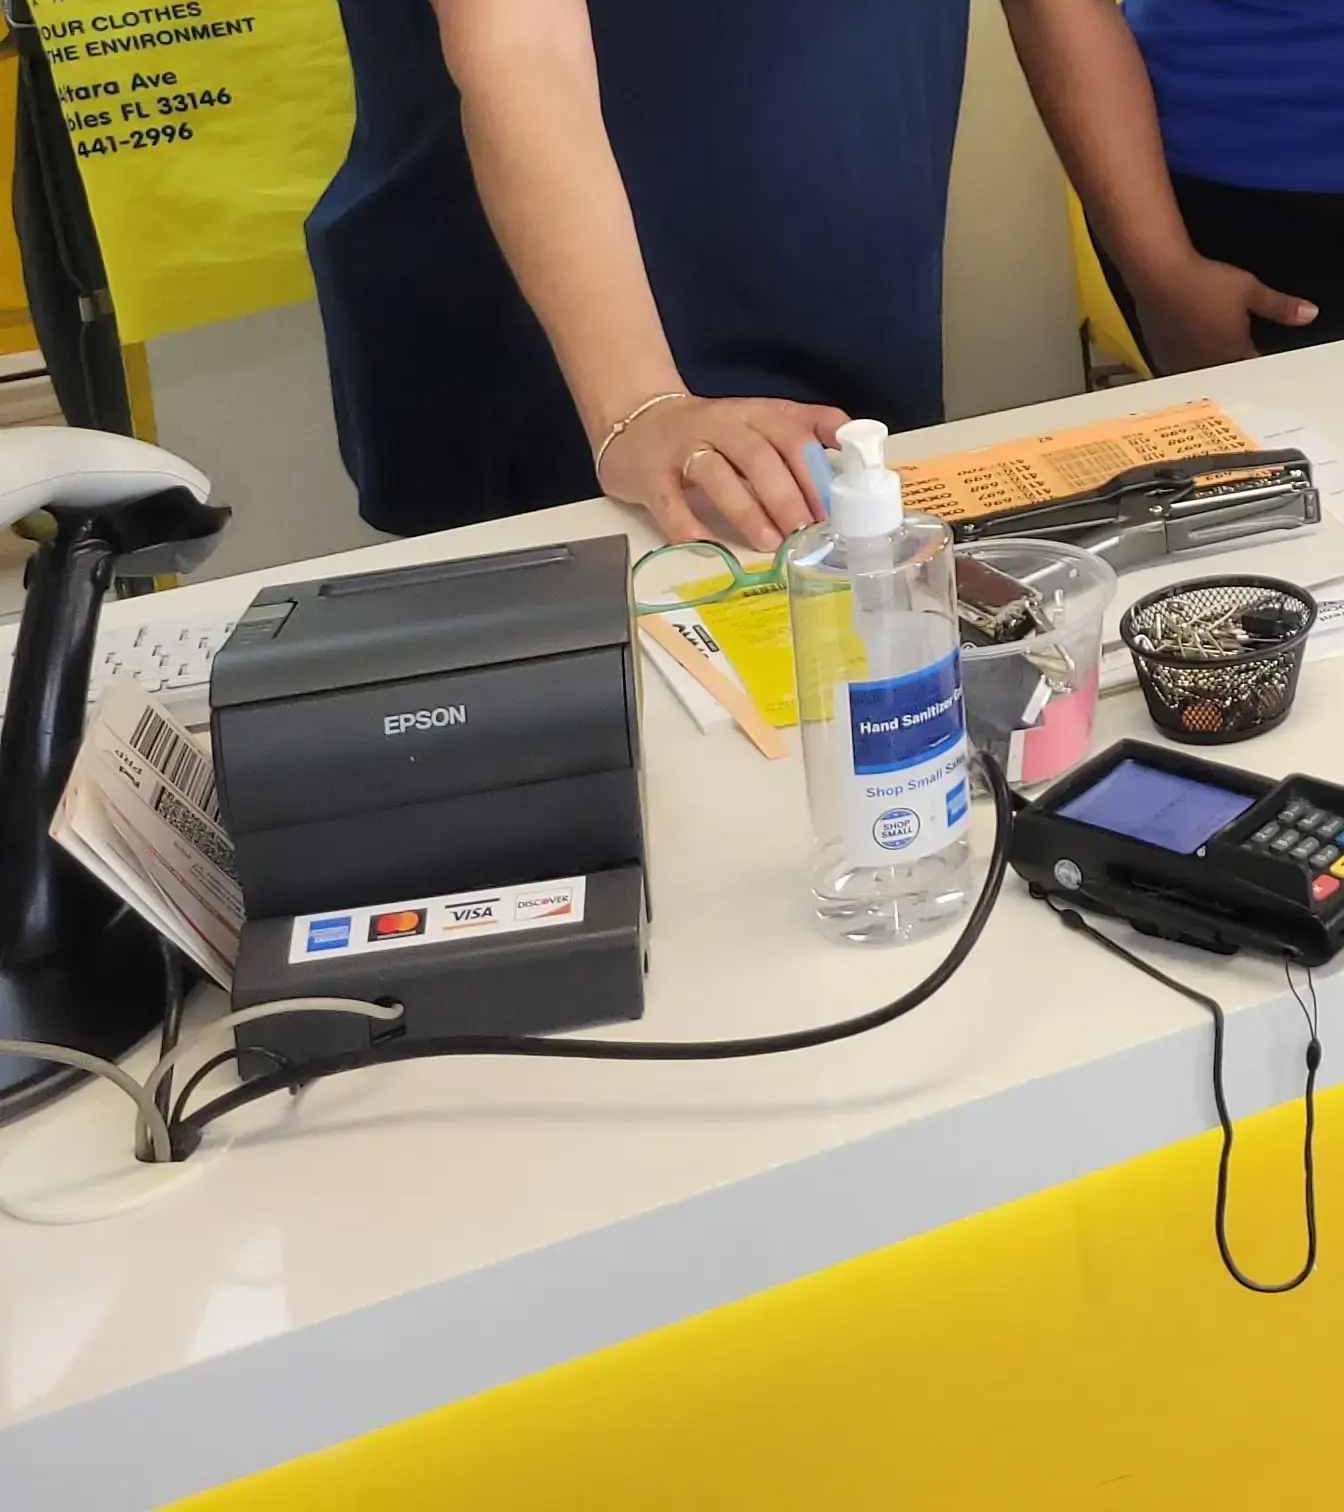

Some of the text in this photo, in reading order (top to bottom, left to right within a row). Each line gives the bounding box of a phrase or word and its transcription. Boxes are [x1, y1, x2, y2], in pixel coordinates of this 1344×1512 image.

[41, 1, 202, 41] OUR CLOTHES
[85, 17, 256, 57] ENVIRONMENT
[130, 71, 177, 92] Ave
[67, 88, 232, 132] bles FL 33146
[77, 123, 194, 159] 441-2996
[383, 704, 467, 737] EPSON
[860, 717, 899, 736] Hand
[901, 695, 953, 727] Sanitizer
[866, 782, 904, 799] Shop
[907, 768, 943, 791] Small
[880, 827, 914, 839] SMALL
[883, 819, 911, 831] SHOP
[452, 906, 493, 922] VISA
[517, 894, 569, 909] DISCOVER
